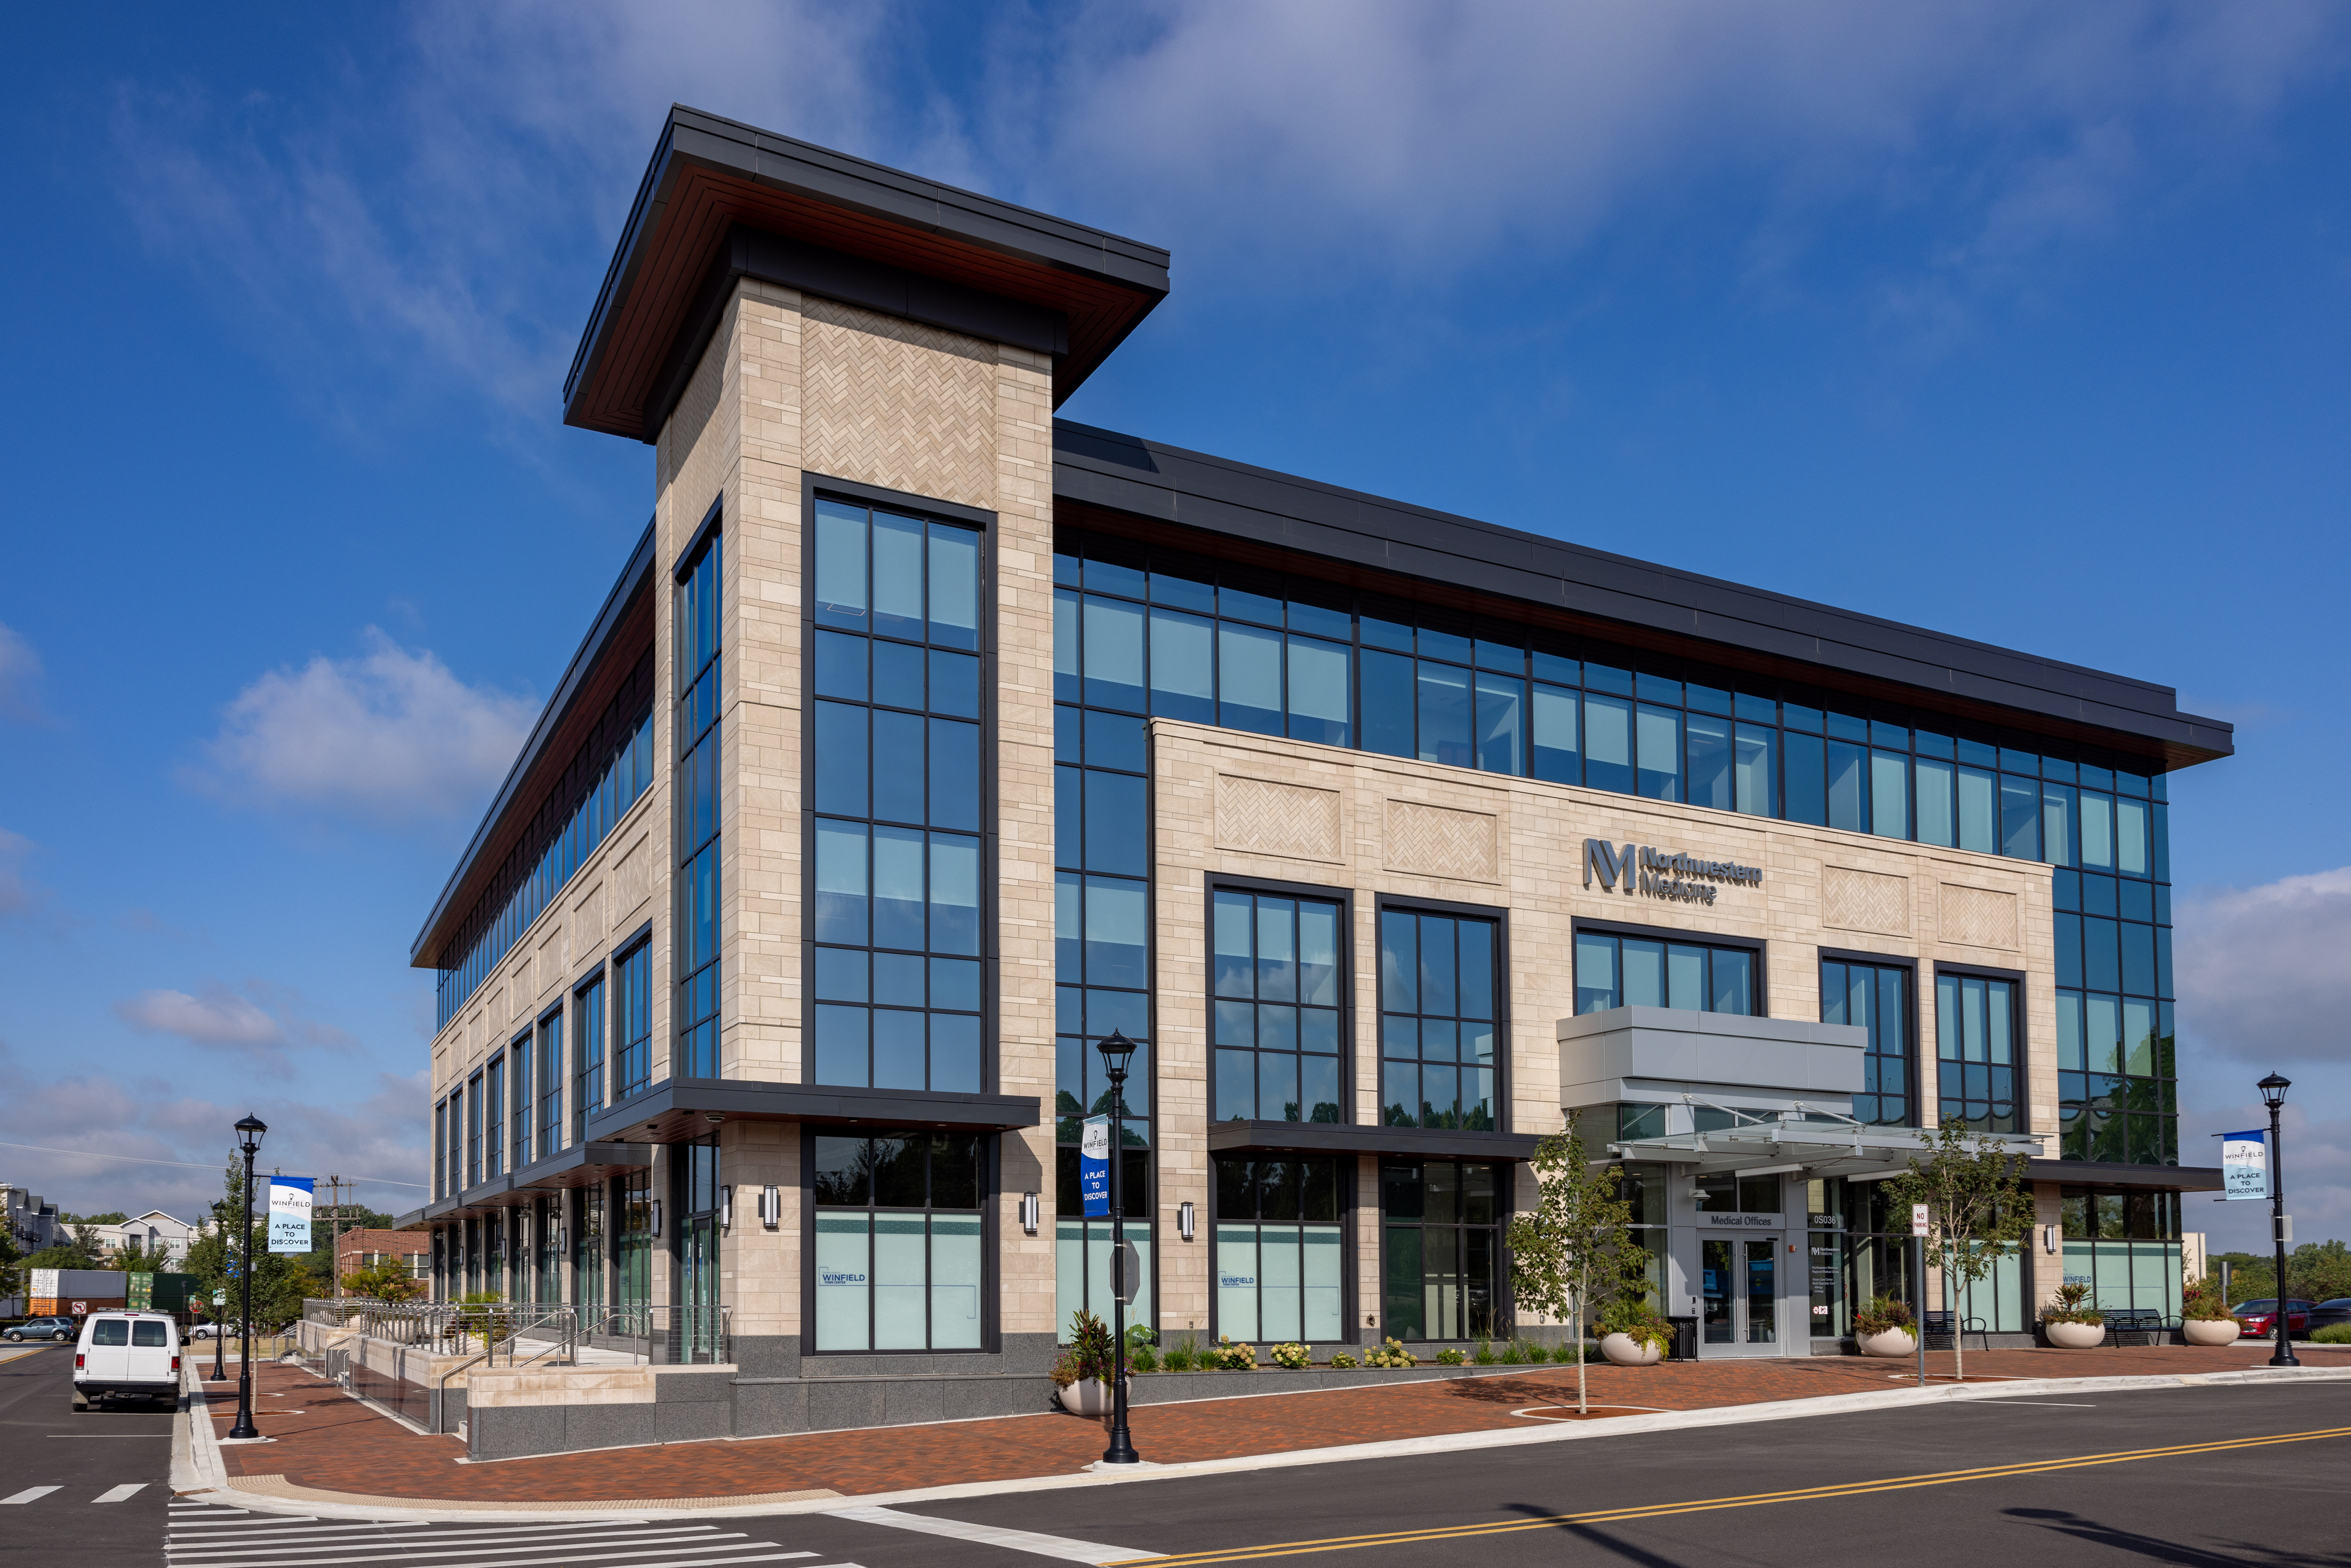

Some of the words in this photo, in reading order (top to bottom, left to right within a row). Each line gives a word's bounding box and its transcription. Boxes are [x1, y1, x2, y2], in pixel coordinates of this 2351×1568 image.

[1640, 846, 1762, 882] Northwestern
[1640, 871, 1717, 900] Medicine
[1084, 1139, 1107, 1149] WINFIELD
[1090, 1170, 1106, 1179] PLACE
[1084, 1191, 1107, 1201] DISCOVER
[1711, 1216, 1742, 1225] Medical
[1744, 1216, 1772, 1225] Offices
